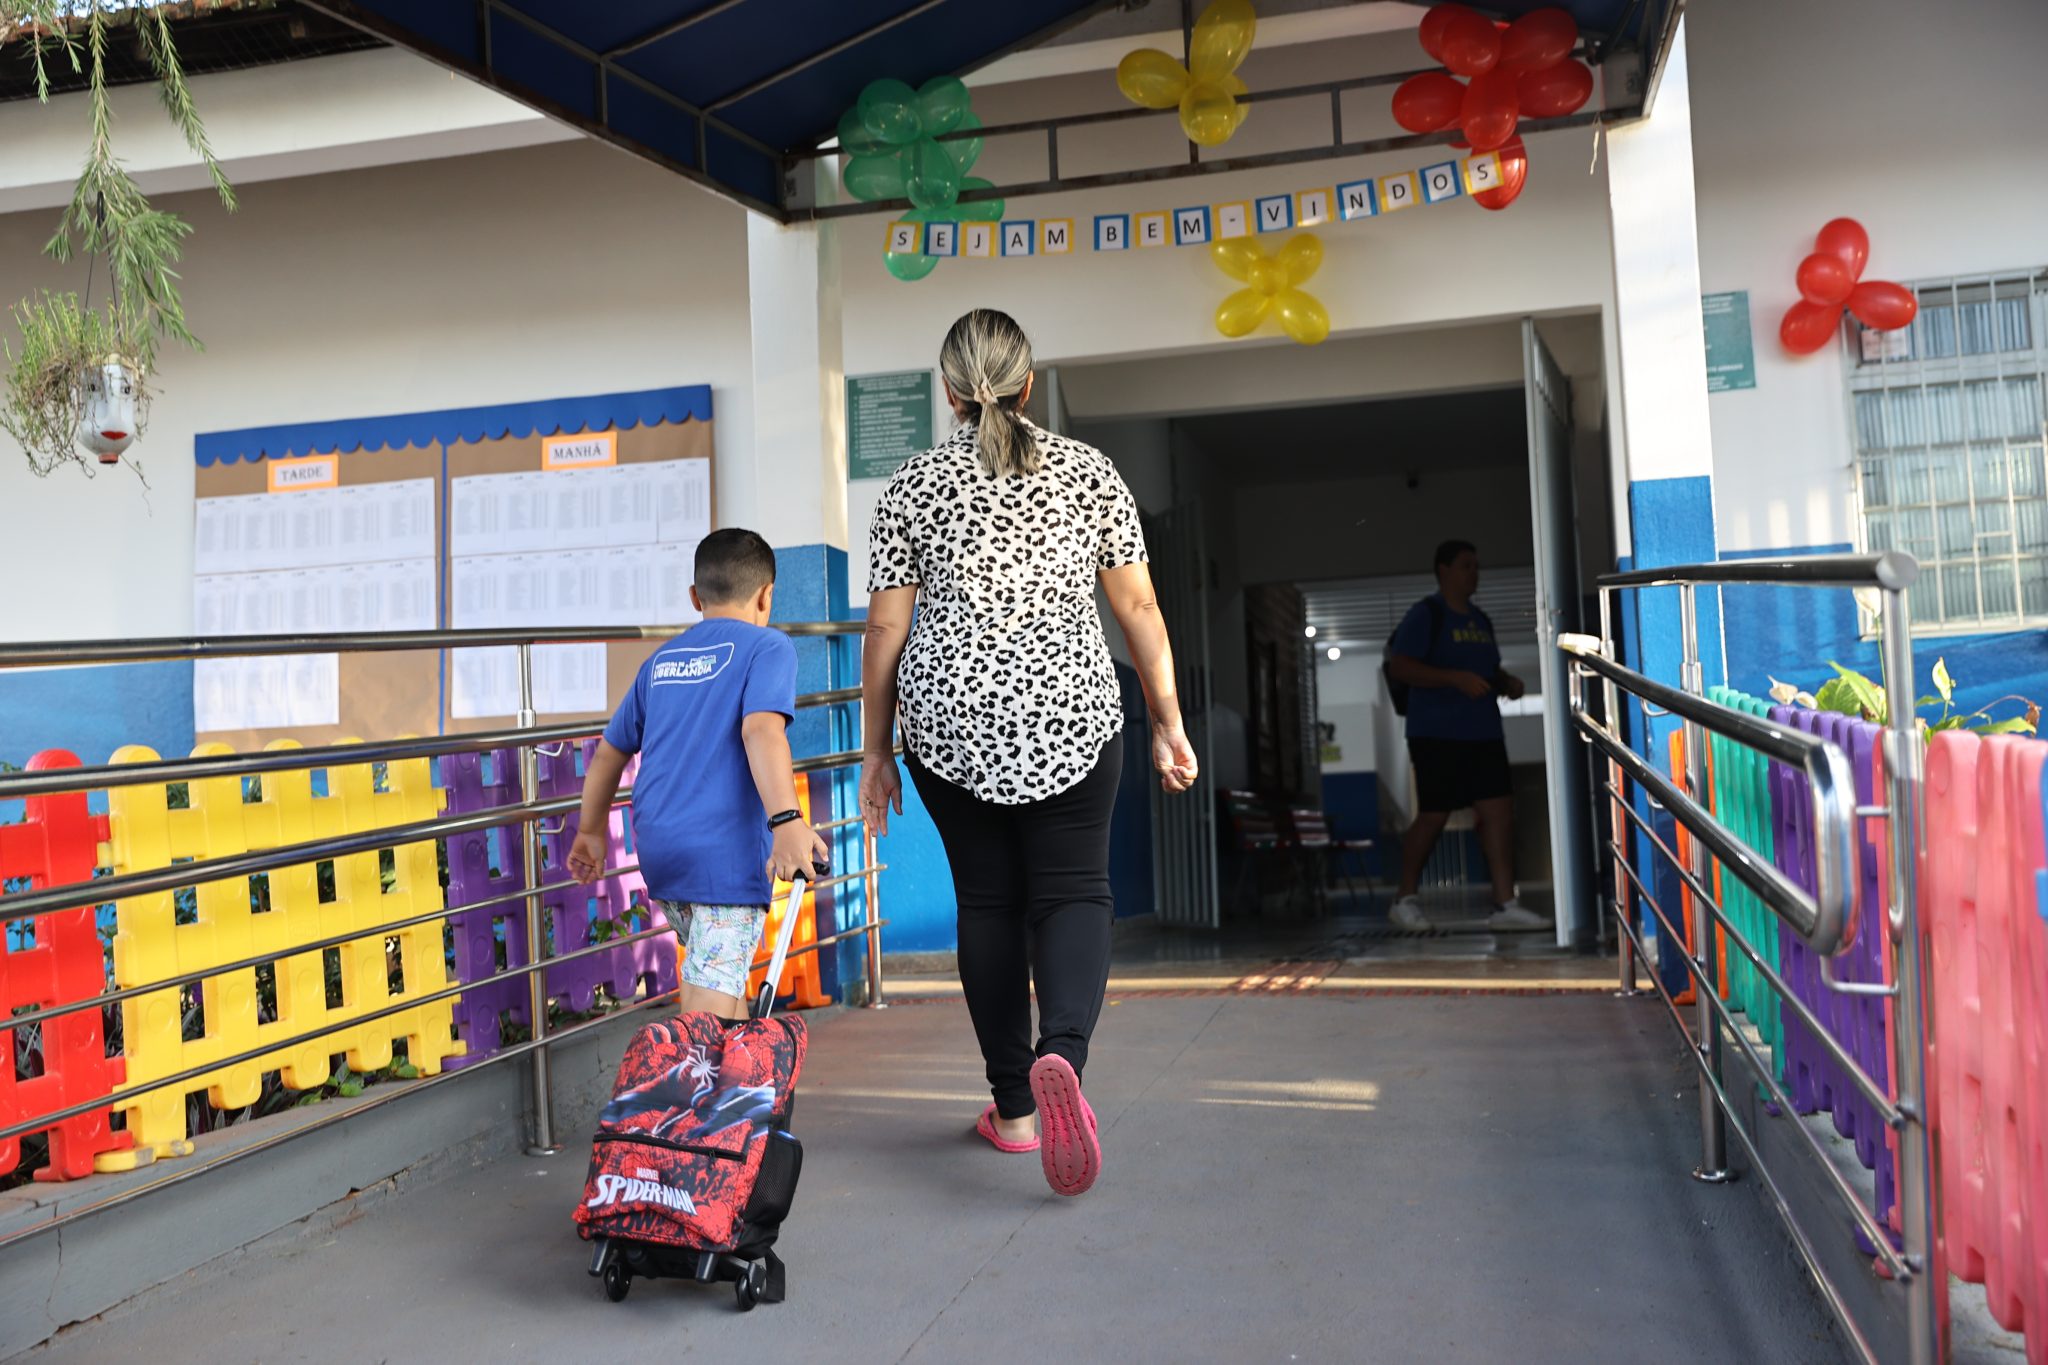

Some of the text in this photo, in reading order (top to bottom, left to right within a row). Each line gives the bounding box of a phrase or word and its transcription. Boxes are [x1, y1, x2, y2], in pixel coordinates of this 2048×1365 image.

[897, 228, 1065, 249] SEJAM
[554, 442, 602, 460] MANHÃ
[281, 466, 323, 482] TARDE
[636, 1167, 659, 1181] MARVEL
[587, 1174, 697, 1216] SPIDER-MAN
